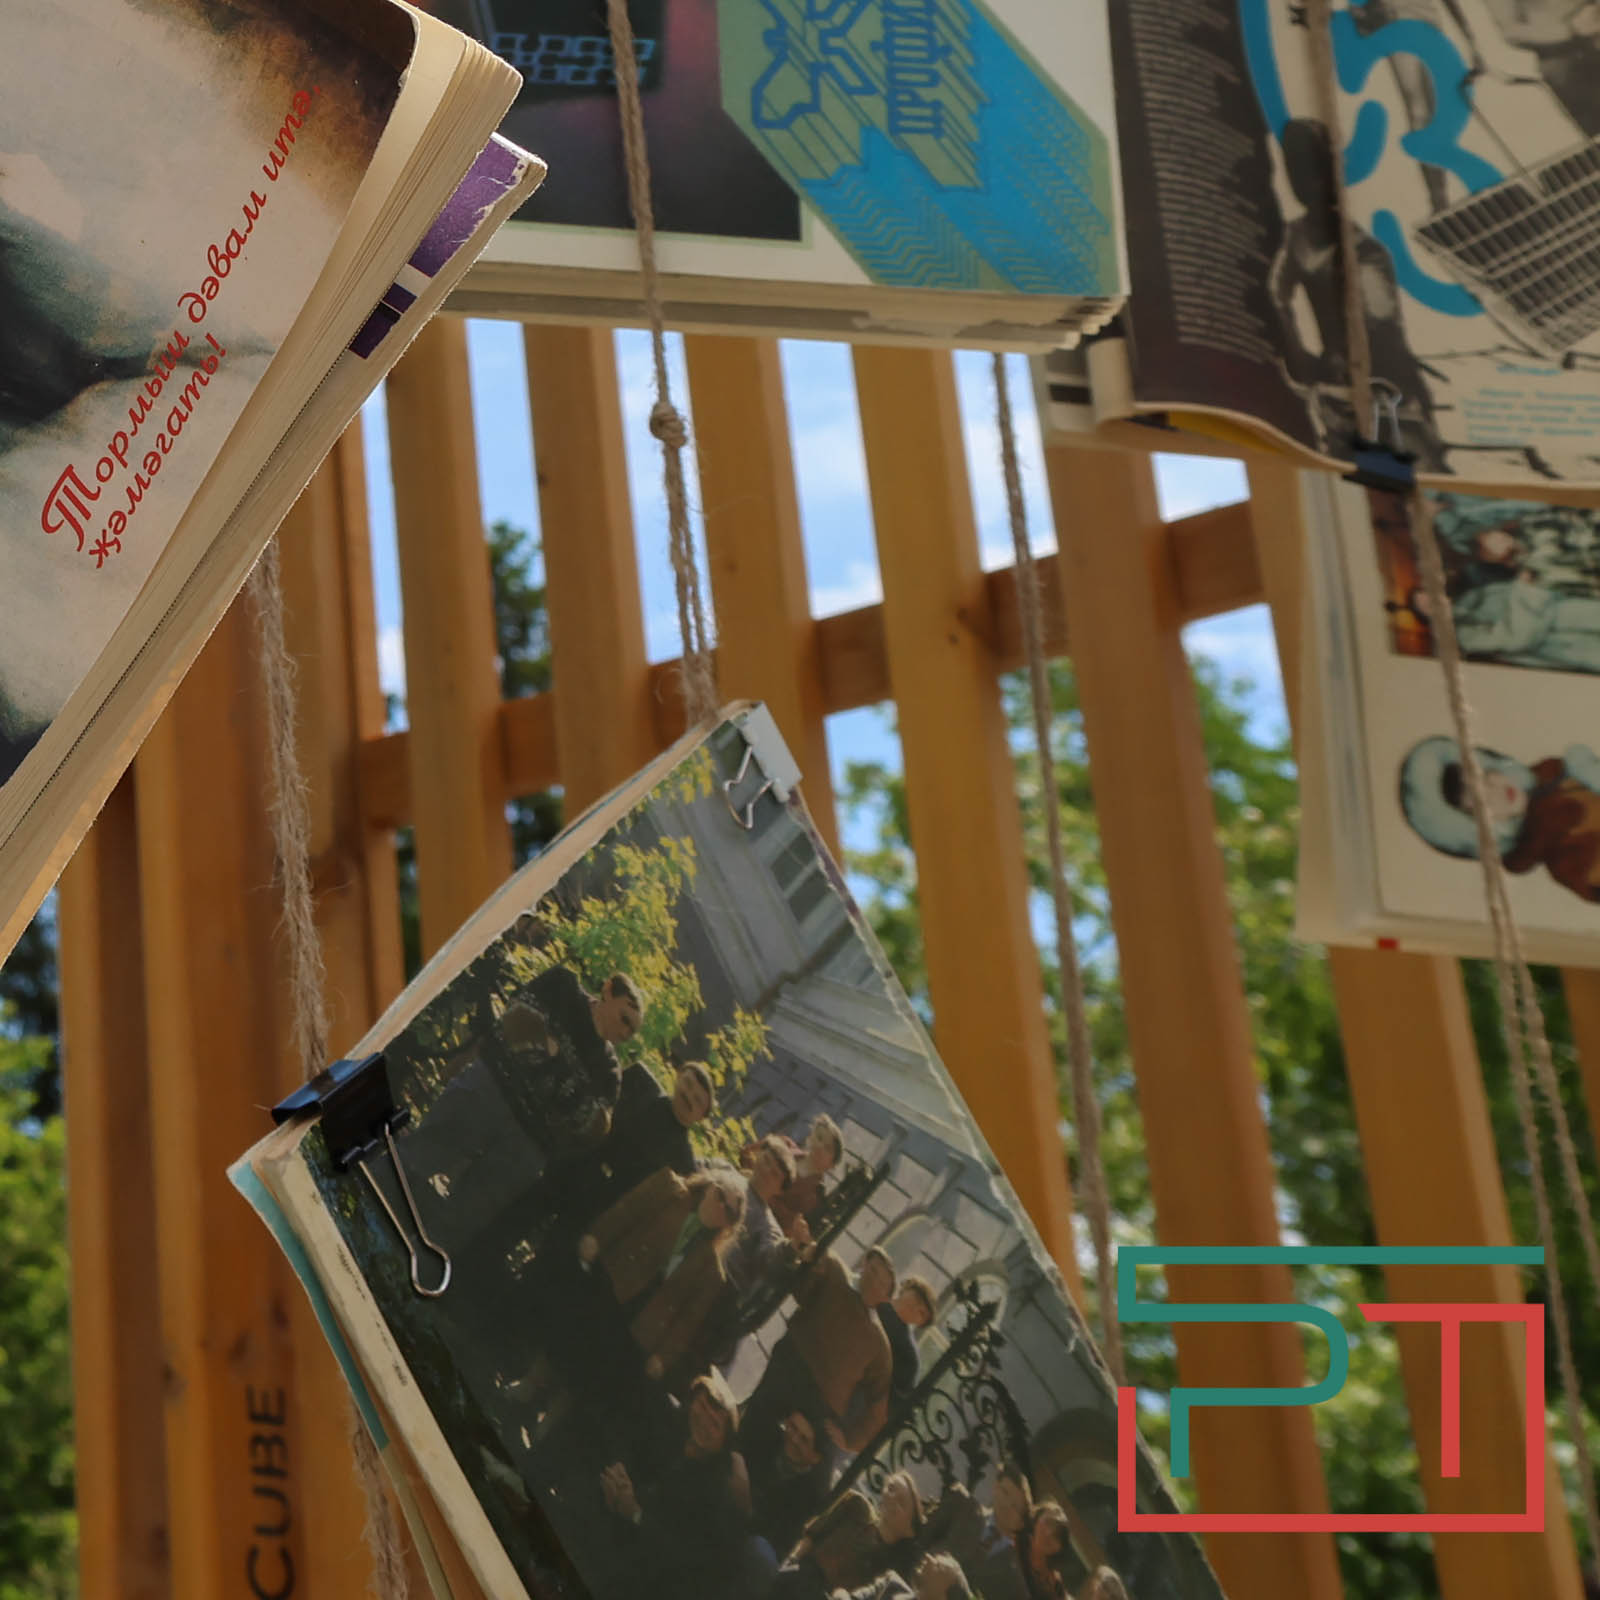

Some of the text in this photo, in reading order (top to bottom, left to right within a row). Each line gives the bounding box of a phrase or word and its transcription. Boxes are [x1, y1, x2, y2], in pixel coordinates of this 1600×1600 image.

[40, 329, 191, 552] Тормыш
[177, 190, 268, 325] дәвам
[89, 332, 228, 570] җәмәгать!
[245, 1384, 296, 1600] CUBE
